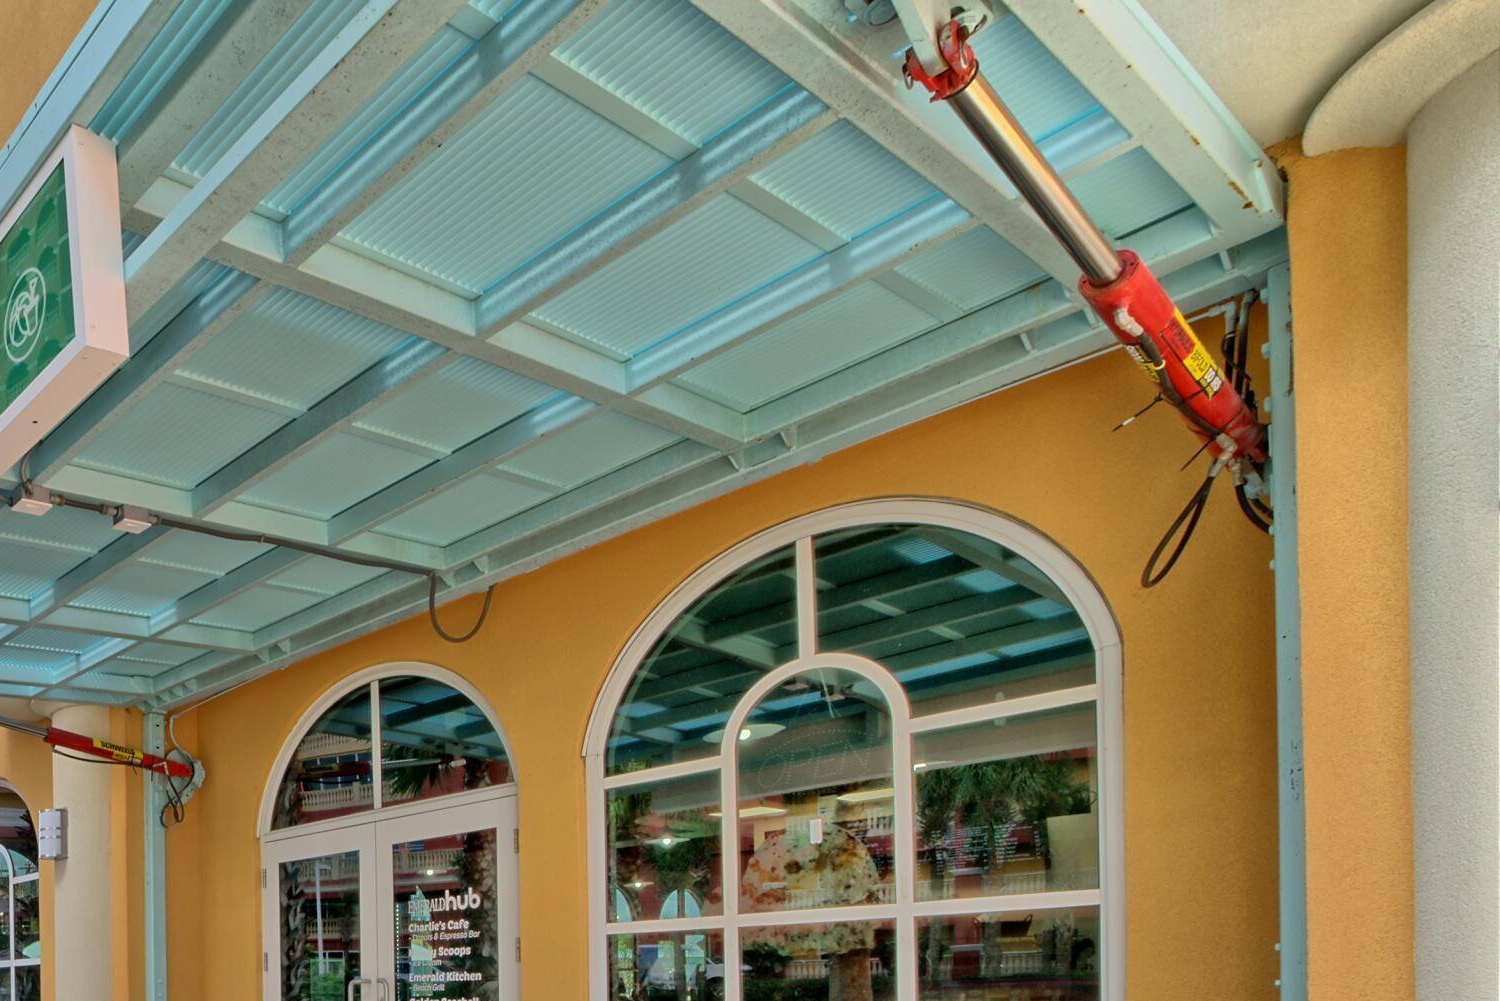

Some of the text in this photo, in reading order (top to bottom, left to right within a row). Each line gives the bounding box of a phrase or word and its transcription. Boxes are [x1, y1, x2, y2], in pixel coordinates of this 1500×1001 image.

[408, 919, 469, 932] Charlie's Cafe
[468, 929, 481, 938] Bar
[438, 946, 471, 957] Scoops
[409, 970, 482, 982] Emerald Kitchen
